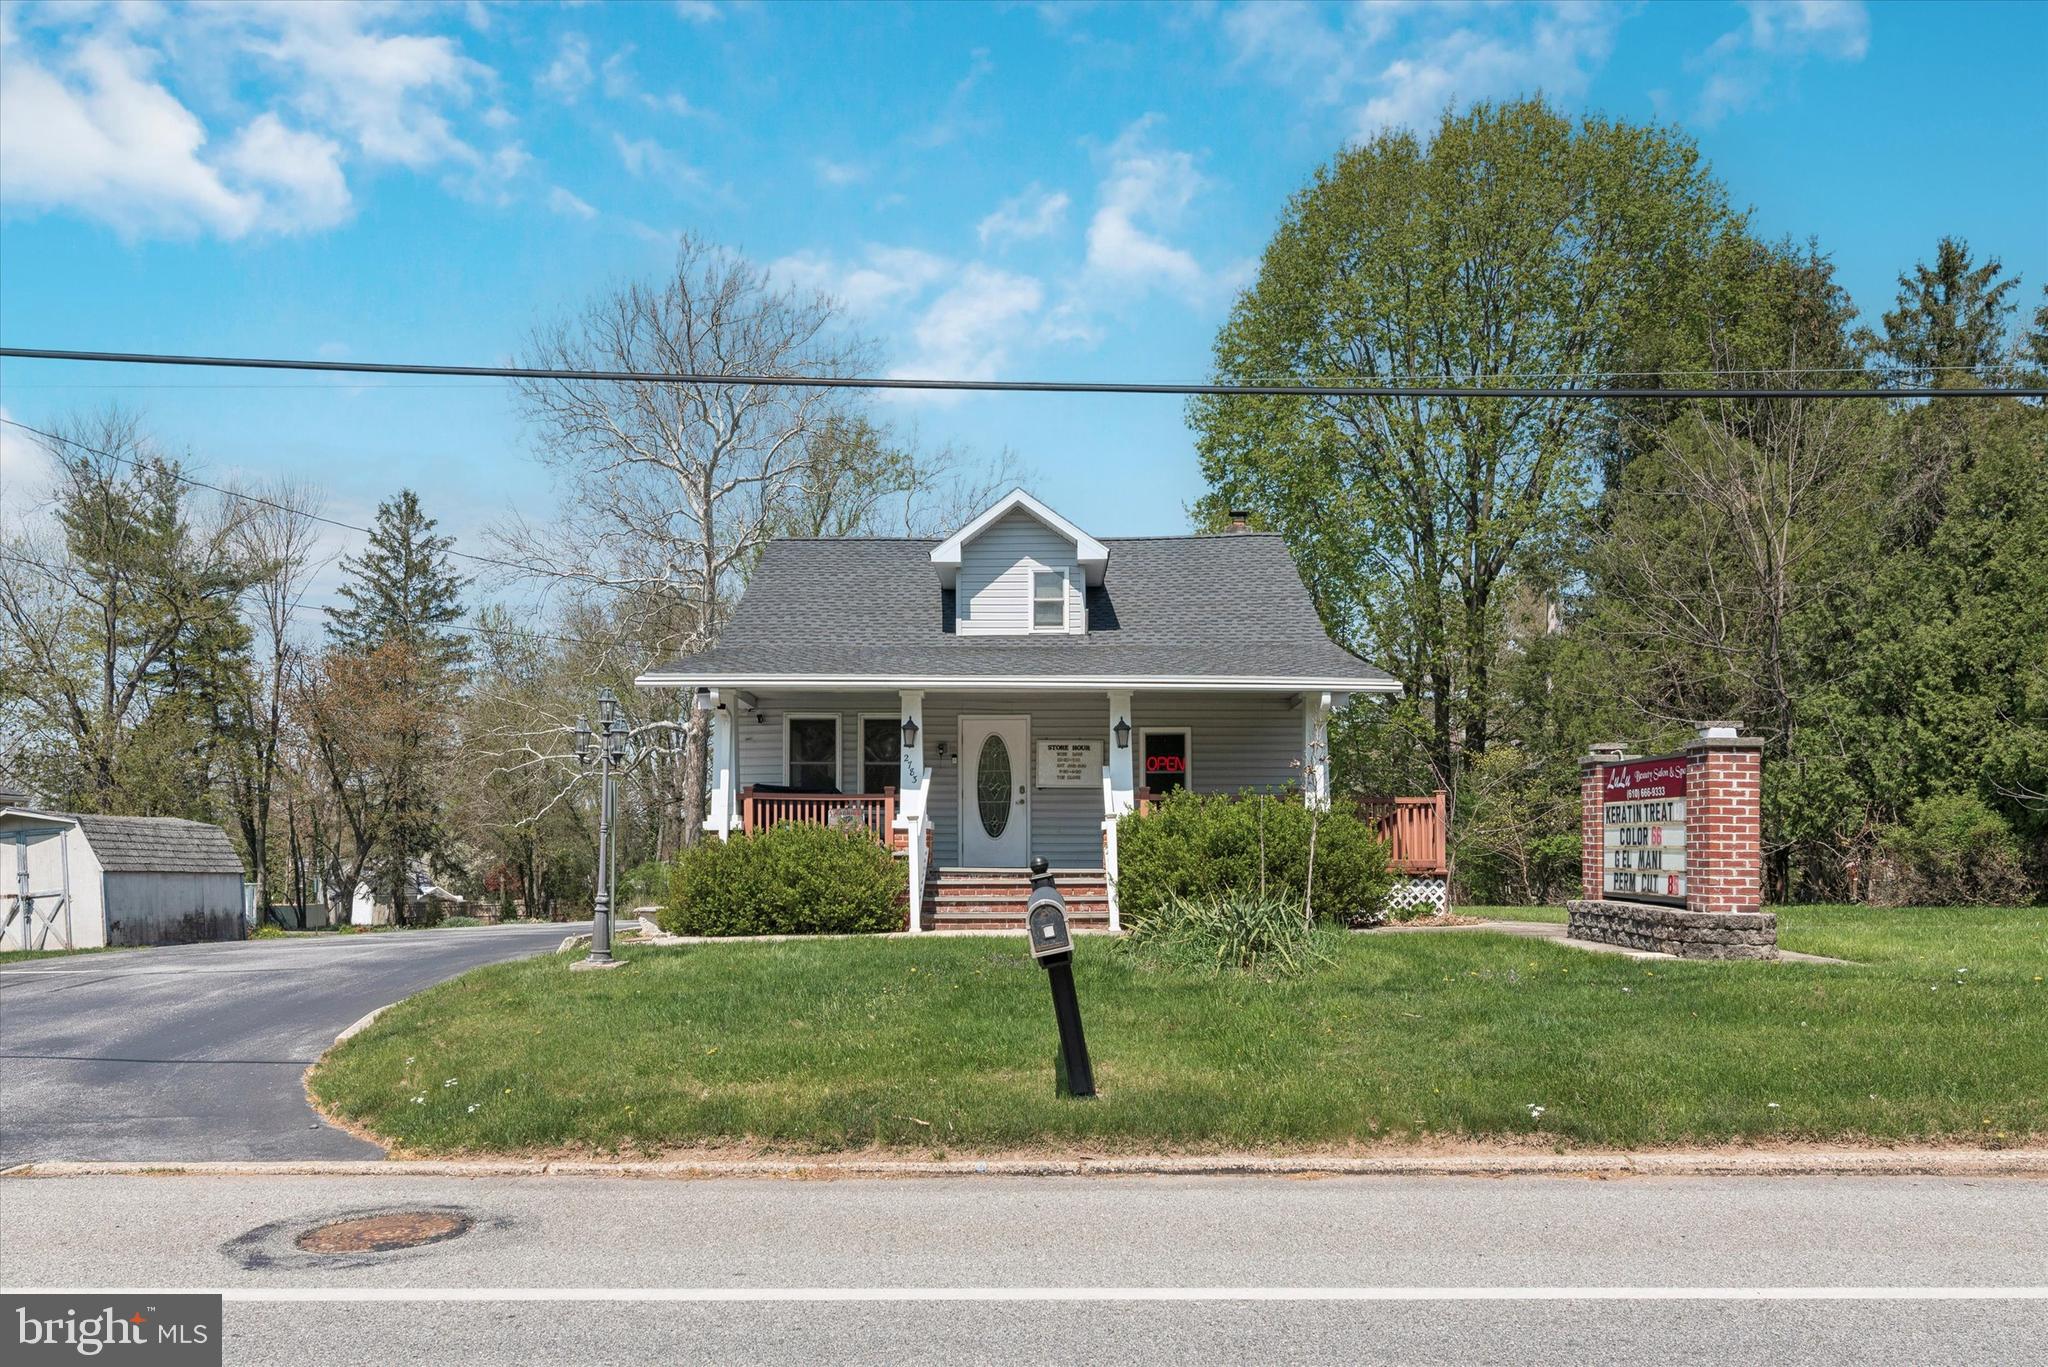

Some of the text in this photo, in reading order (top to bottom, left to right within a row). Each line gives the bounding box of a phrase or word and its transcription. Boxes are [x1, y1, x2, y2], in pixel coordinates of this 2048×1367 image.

[1146, 755, 1185, 773] OPEN
[1606, 802, 1673, 824] KERATIN TREAT
[1620, 826, 1663, 846] COLOR 66
[1638, 850, 1662, 870] MANI
[1613, 872, 1636, 892] PERM
